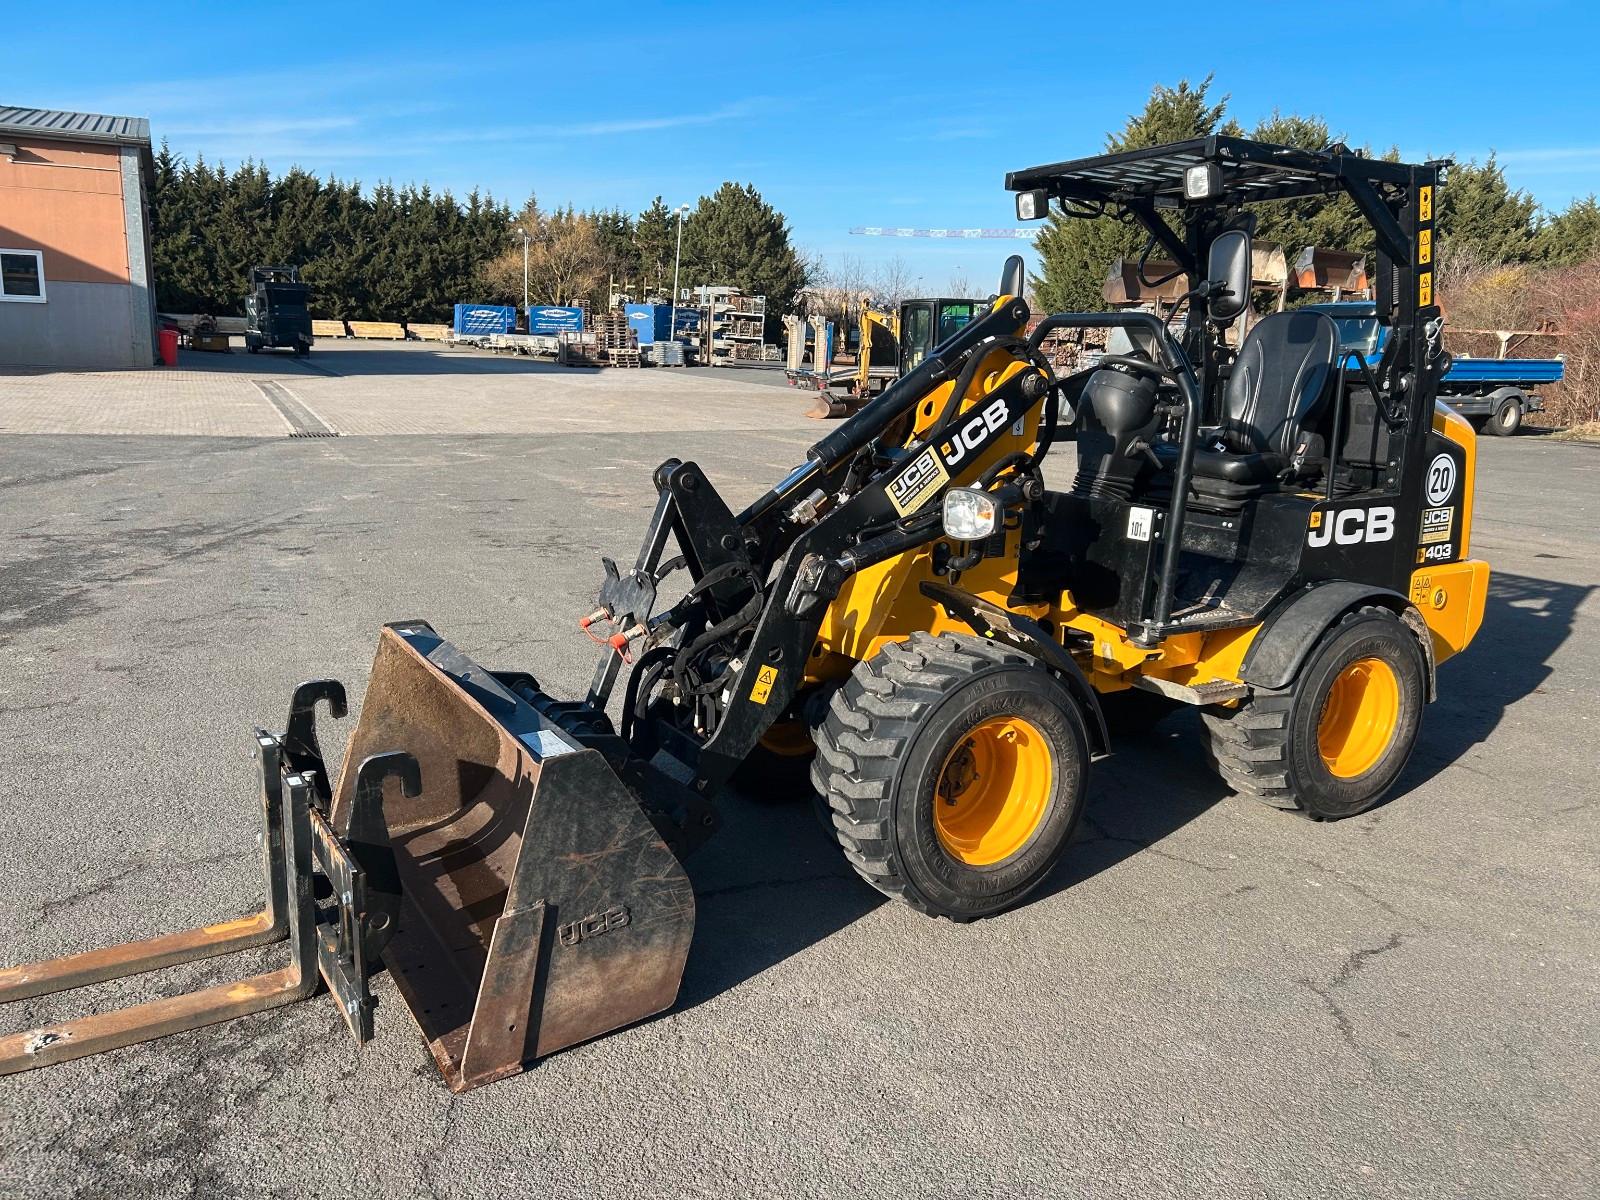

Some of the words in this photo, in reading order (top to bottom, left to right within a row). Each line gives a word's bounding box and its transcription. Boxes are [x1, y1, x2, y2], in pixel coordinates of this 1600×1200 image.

[945, 398, 1009, 466] JCB
[895, 453, 934, 497] JCB
[1430, 467, 1449, 493] 20
[1131, 521, 1142, 537] 101
[1308, 506, 1395, 548] JCB
[1424, 510, 1450, 524] JCB
[1426, 543, 1452, 559] 403
[557, 904, 632, 947] JCB
